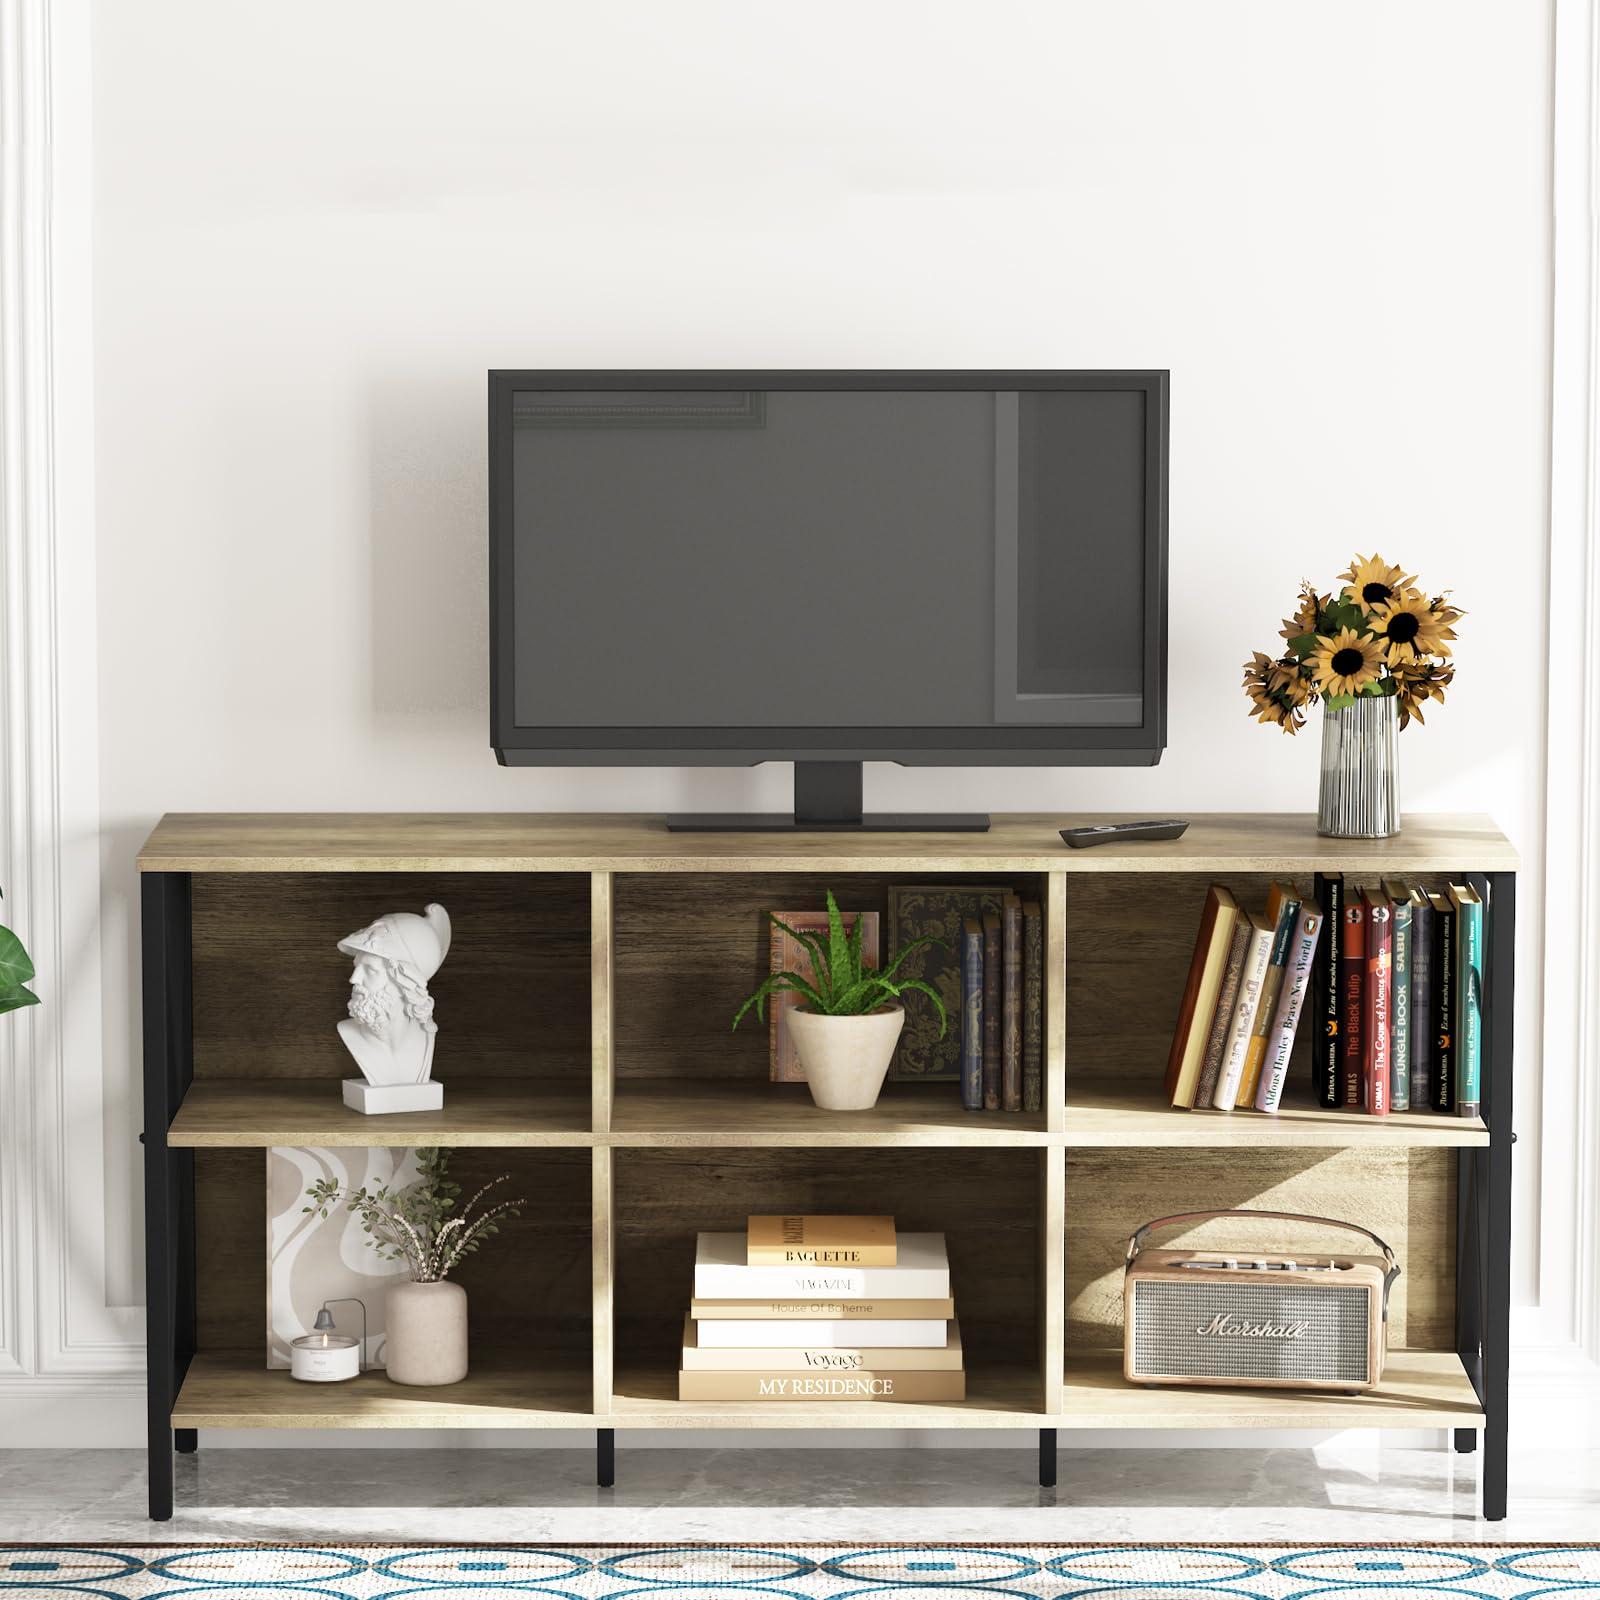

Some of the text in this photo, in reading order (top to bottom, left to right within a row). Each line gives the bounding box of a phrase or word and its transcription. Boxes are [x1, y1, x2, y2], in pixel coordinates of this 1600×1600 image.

[1396, 931, 1405, 973] SABU
[1283, 939, 1312, 1029] Brave New World
[1347, 974, 1361, 1056] The Black Tulip
[1375, 948, 1386, 1070] The Count of Monte Cristo
[1397, 985, 1407, 1077] JUNGLE BOOK
[1265, 1036, 1291, 1106] Aldous Huxley
[1347, 1073, 1358, 1104] DUMAS
[785, 1250, 861, 1262] BAGUETTE
[772, 1303, 873, 1313] House Of Boheme
[1197, 1313, 1309, 1339] Marshall
[803, 1351, 864, 1370] Voyage
[759, 1378, 894, 1395] MY RESIDENCE
